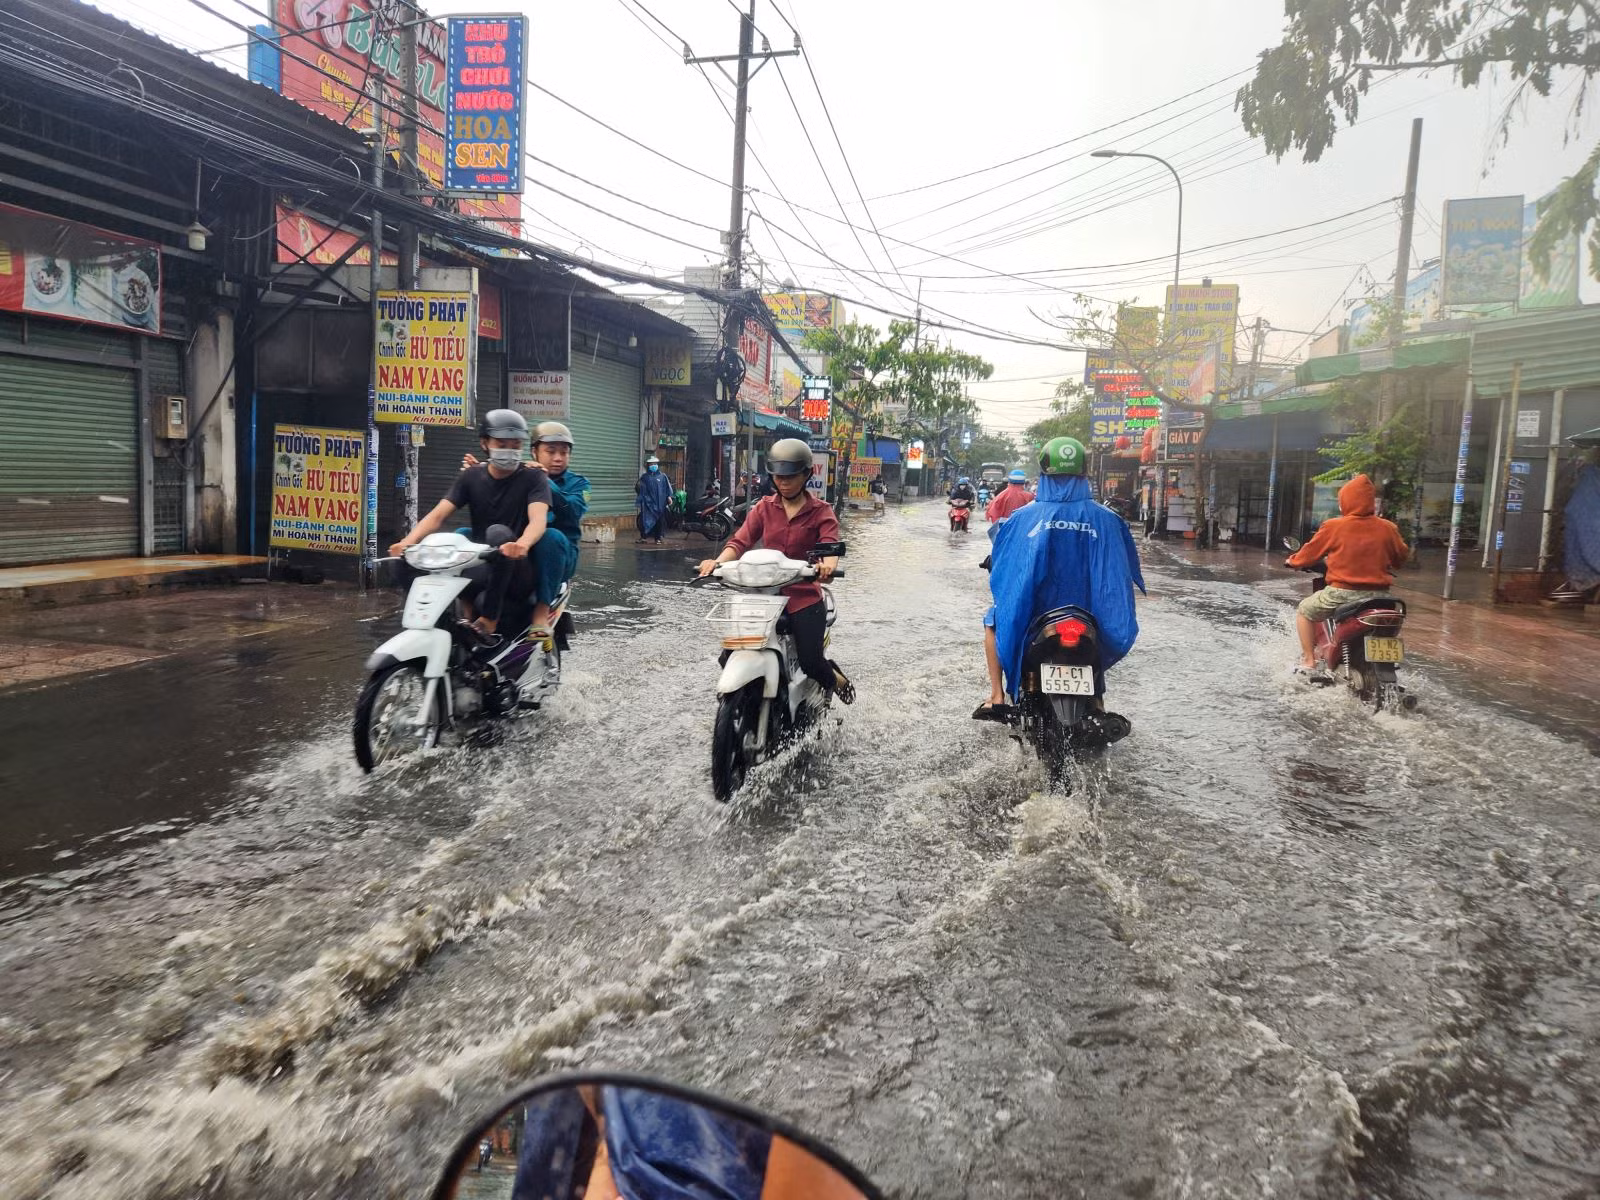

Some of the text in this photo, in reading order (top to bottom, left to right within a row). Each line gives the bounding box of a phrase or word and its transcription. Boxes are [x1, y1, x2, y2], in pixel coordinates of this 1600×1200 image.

[454, 116, 512, 139] HOA
[455, 142, 510, 168] SEN
[378, 296, 467, 322] TƯỜNG PHÁT
[410, 326, 429, 360] HỦ
[433, 326, 465, 361] TIẾU
[378, 365, 465, 391] NAM VANG
[651, 367, 686, 384] NGỌC
[377, 403, 389, 412] MÌ
[392, 404, 426, 414] HOÀNH
[433, 395, 462, 405] CANH
[1093, 404, 1121, 416] CHUYÊN
[275, 432, 362, 458] TƯỜNG PHÁT
[306, 460, 325, 491] HỦ
[329, 461, 360, 494] TIẾU
[274, 494, 359, 522] NAM VANG
[272, 529, 284, 537] MÌ
[288, 530, 321, 542] HOÀNH
[328, 524, 357, 534] CANH
[1044, 520, 1098, 539] HONDA
[1371, 650, 1398, 660] 7353
[1046, 680, 1090, 692] 555.73
